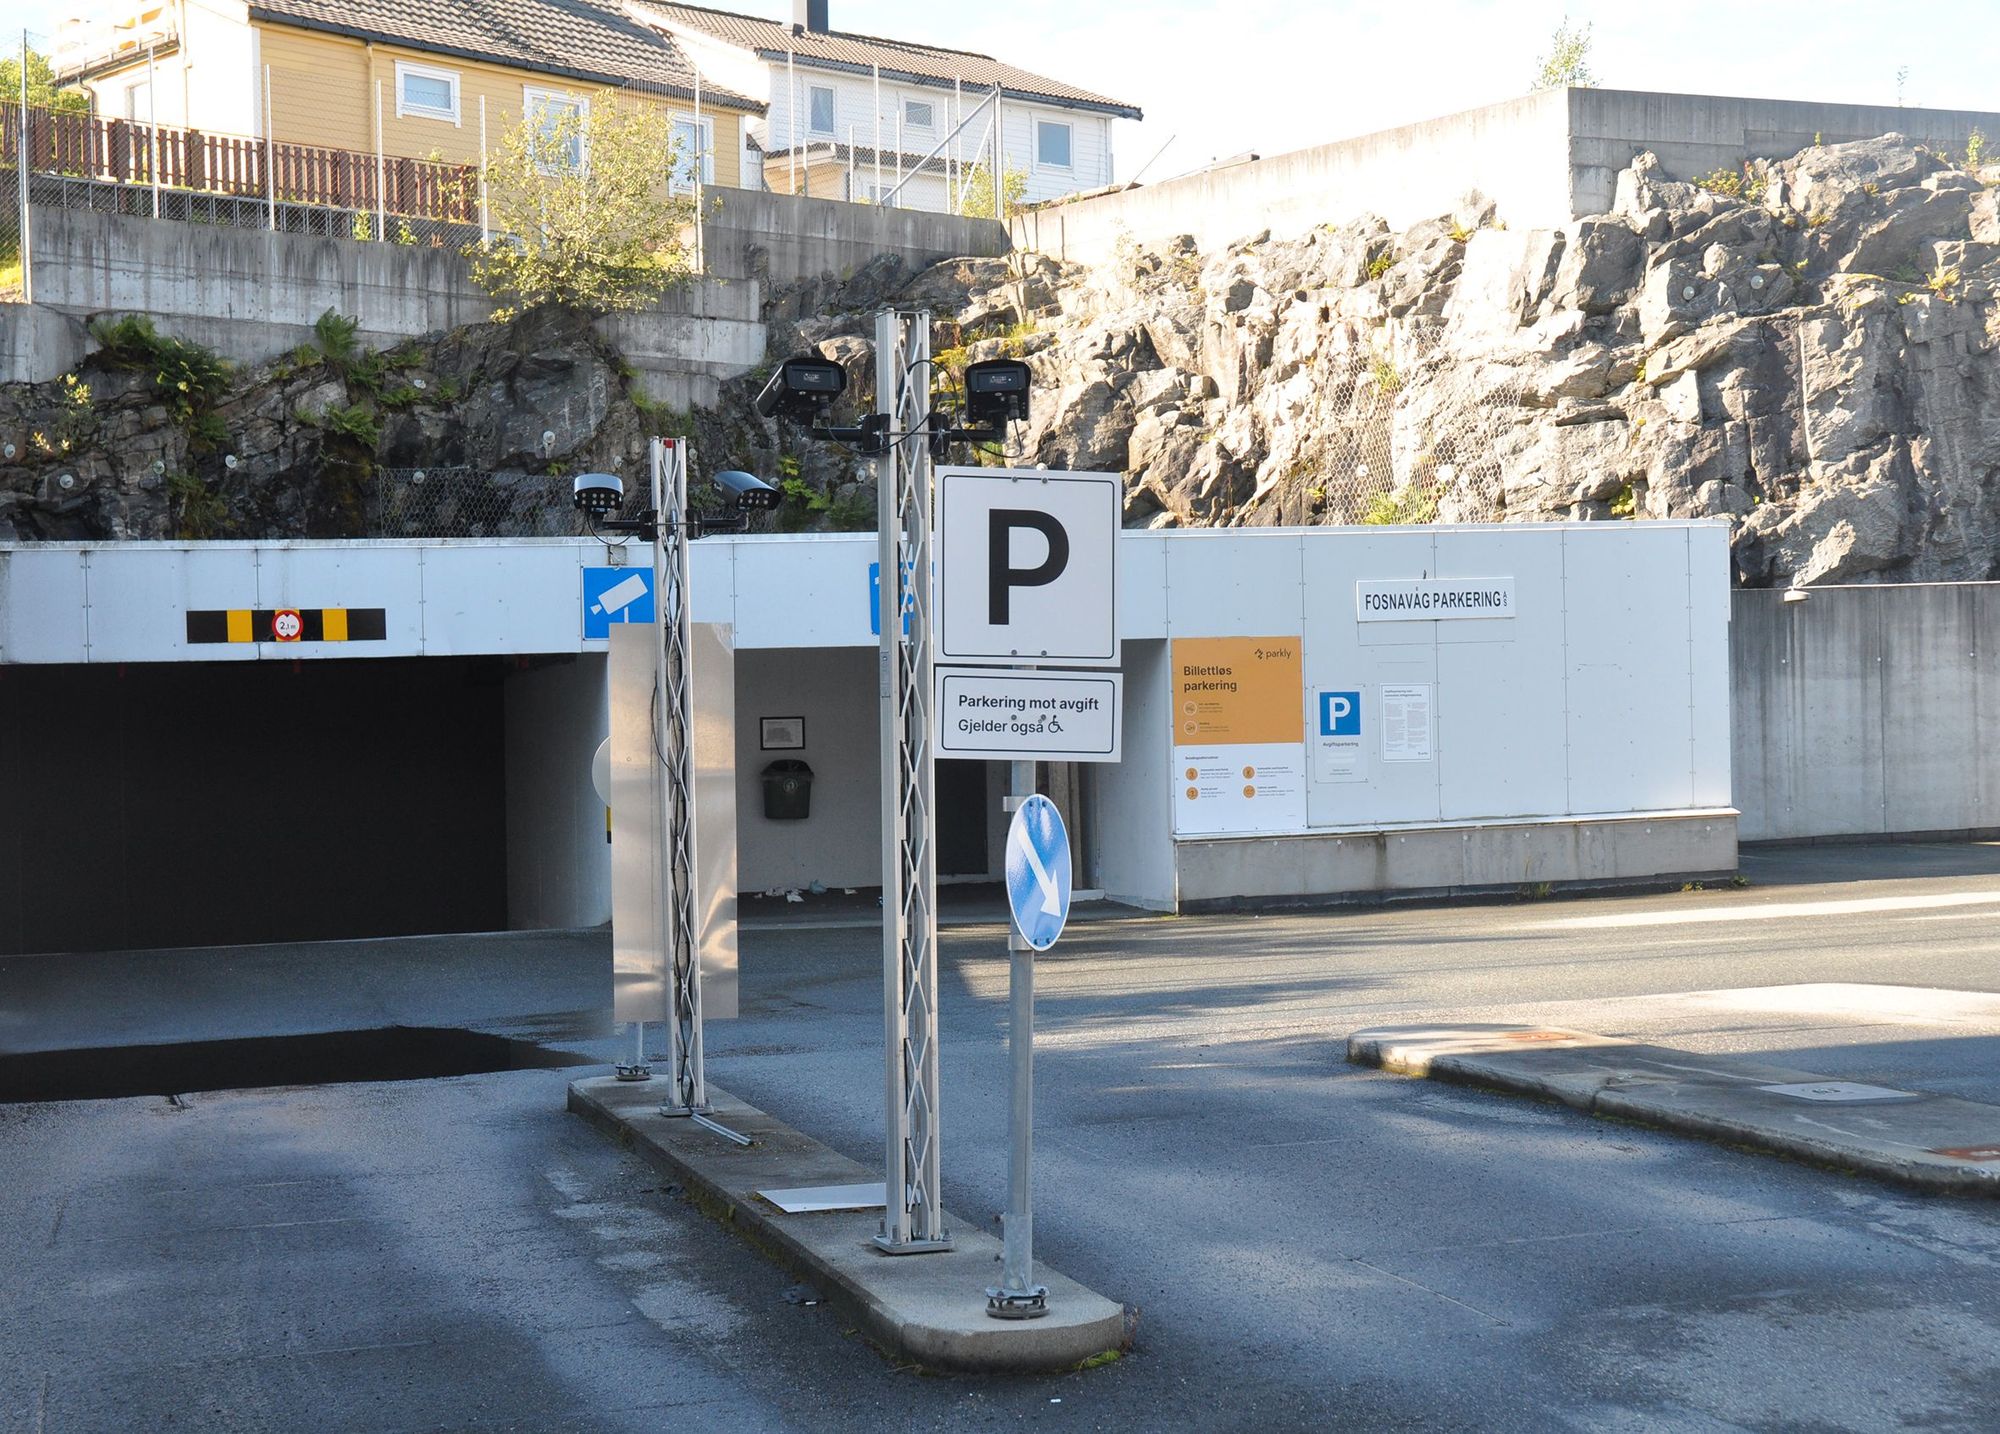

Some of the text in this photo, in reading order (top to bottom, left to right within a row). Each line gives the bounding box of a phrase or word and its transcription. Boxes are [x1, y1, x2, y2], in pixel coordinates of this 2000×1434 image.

[988, 508, 1070, 625] P
[1365, 587, 1430, 610] FOSNAVÅG
[1433, 591, 1501, 609] PARKERING
[1265, 648, 1292, 660] parkly
[1183, 665, 1232, 676] Billettløs
[1184, 680, 1238, 693] parkering
[958, 694, 1100, 713] Parkering mot avgift
[1329, 696, 1351, 731] P
[958, 718, 1044, 737] Gjelder også
